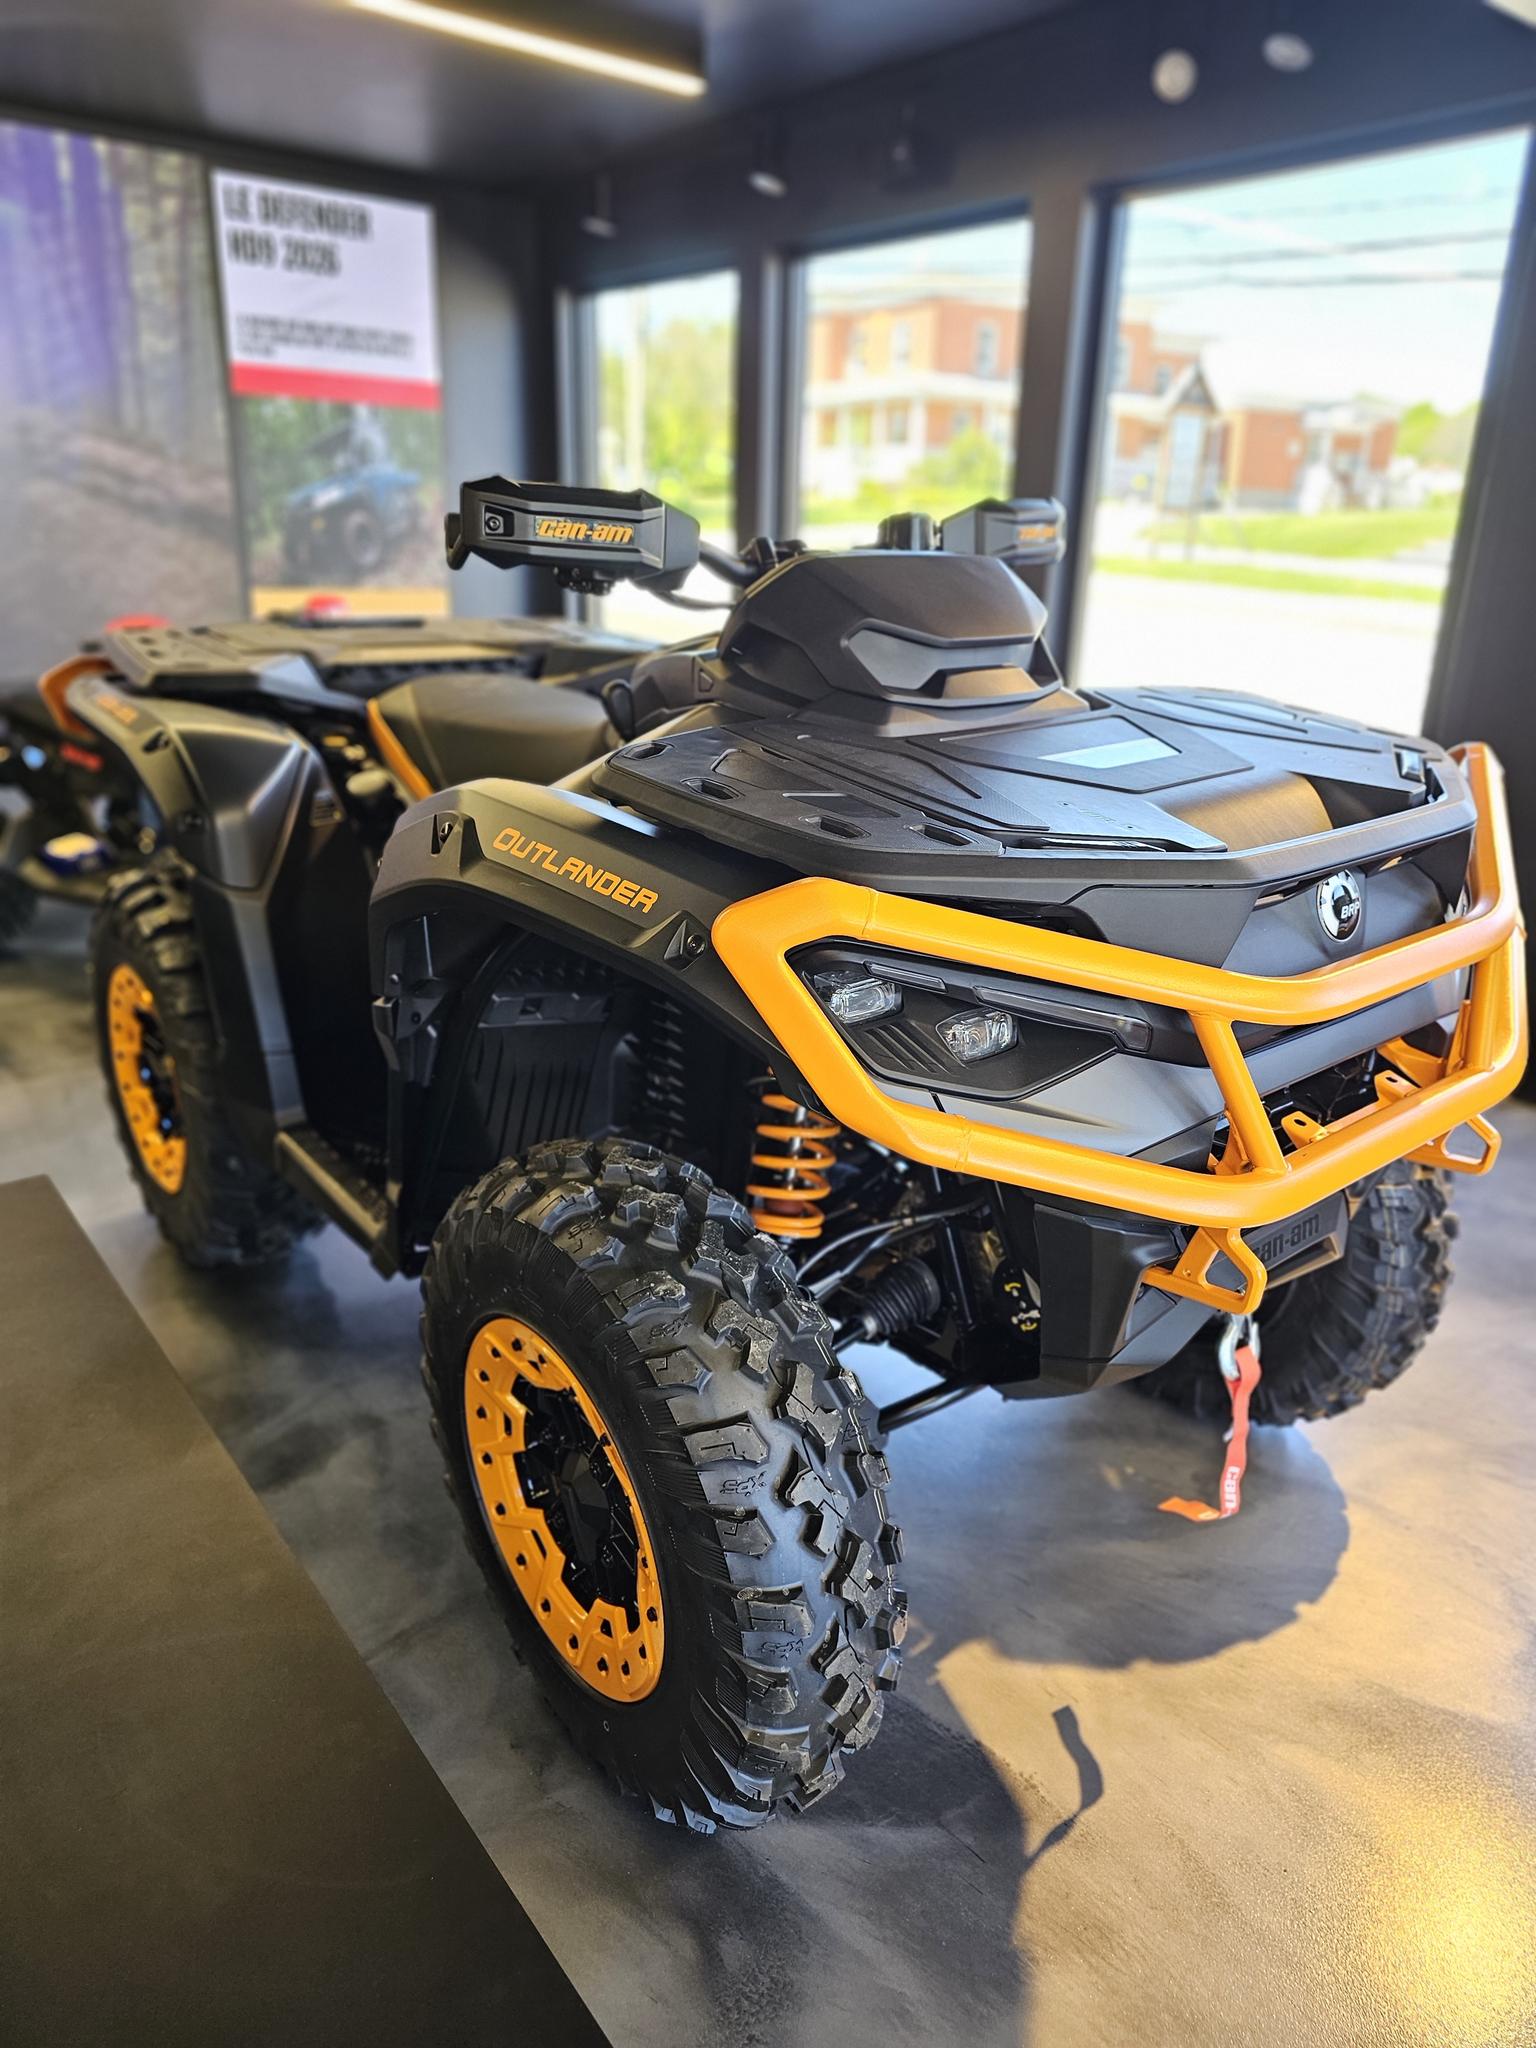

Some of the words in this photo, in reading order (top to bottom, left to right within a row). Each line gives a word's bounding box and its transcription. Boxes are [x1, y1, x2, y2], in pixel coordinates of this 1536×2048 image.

[538, 519, 634, 543] can-am
[492, 827, 659, 914] OUTLANDER
[1340, 901, 1361, 919] BRP
